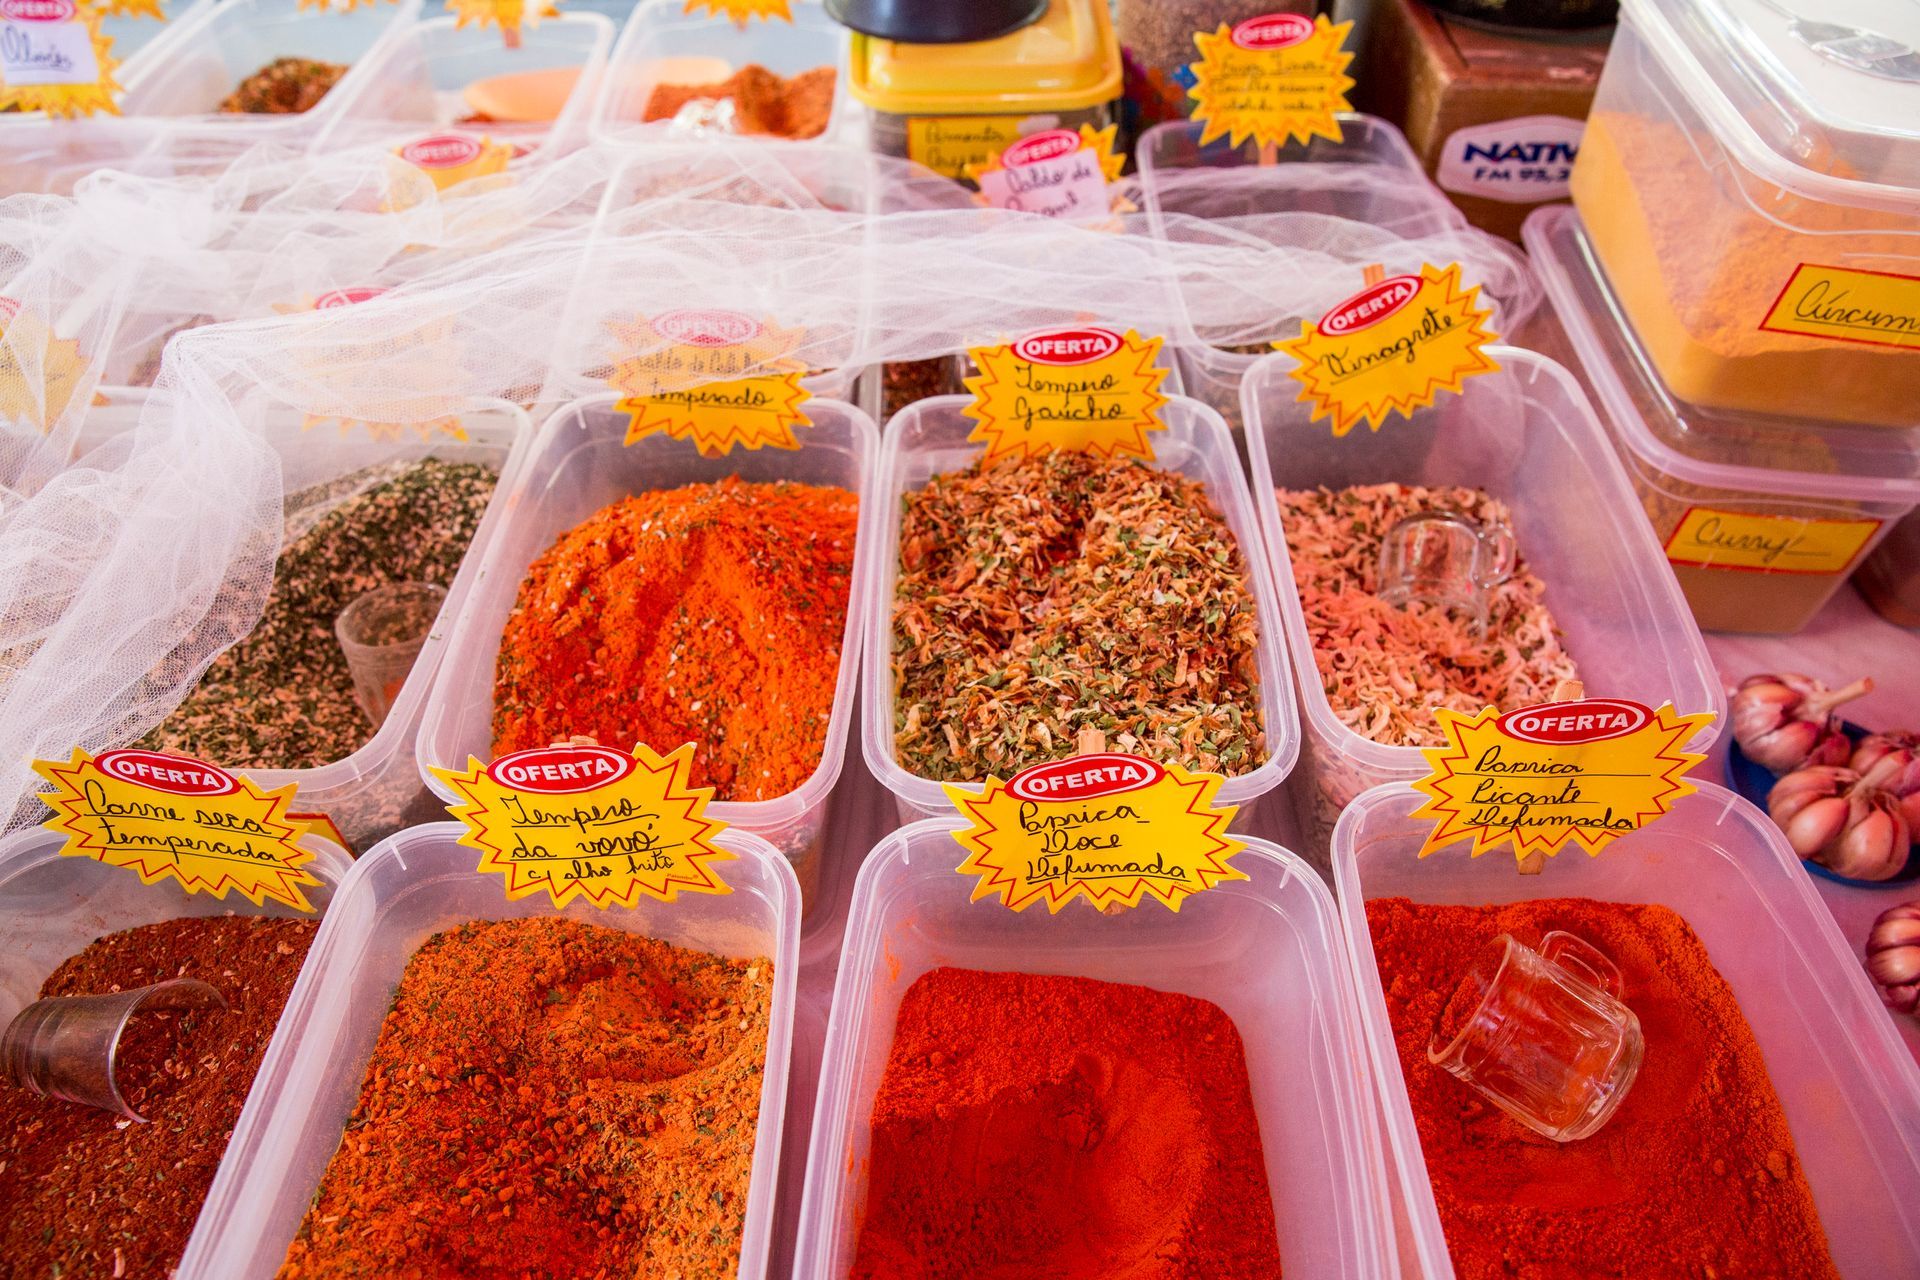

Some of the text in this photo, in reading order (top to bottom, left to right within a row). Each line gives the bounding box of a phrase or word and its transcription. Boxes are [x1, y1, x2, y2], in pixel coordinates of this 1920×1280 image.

[1240, 23, 1304, 41] OFERTA
[1009, 138, 1070, 164] OFERTA
[1474, 168, 1511, 181] FM
[1332, 284, 1410, 330] OFERTA
[1026, 338, 1108, 355] OFERTA
[1319, 307, 1452, 376] Vinagrete
[1015, 364, 1120, 398] Tempero
[1696, 517, 1804, 563] Curry
[1519, 713, 1629, 732] OFERTA
[507, 758, 614, 783] OFERTA
[1475, 745, 1584, 774] Paprica
[116, 760, 219, 788] OFERTA
[1028, 765, 1142, 793] OFERTA
[1471, 778, 1581, 804] Picante
[85, 779, 272, 835] Carne seca
[500, 795, 642, 833] Tempero
[1464, 805, 1634, 833] Defumada
[98, 817, 281, 864] temperada
[511, 823, 660, 859] da vovó
[1040, 829, 1122, 853] Doce
[563, 859, 613, 880] alho
[1025, 852, 1187, 885] Defumada
